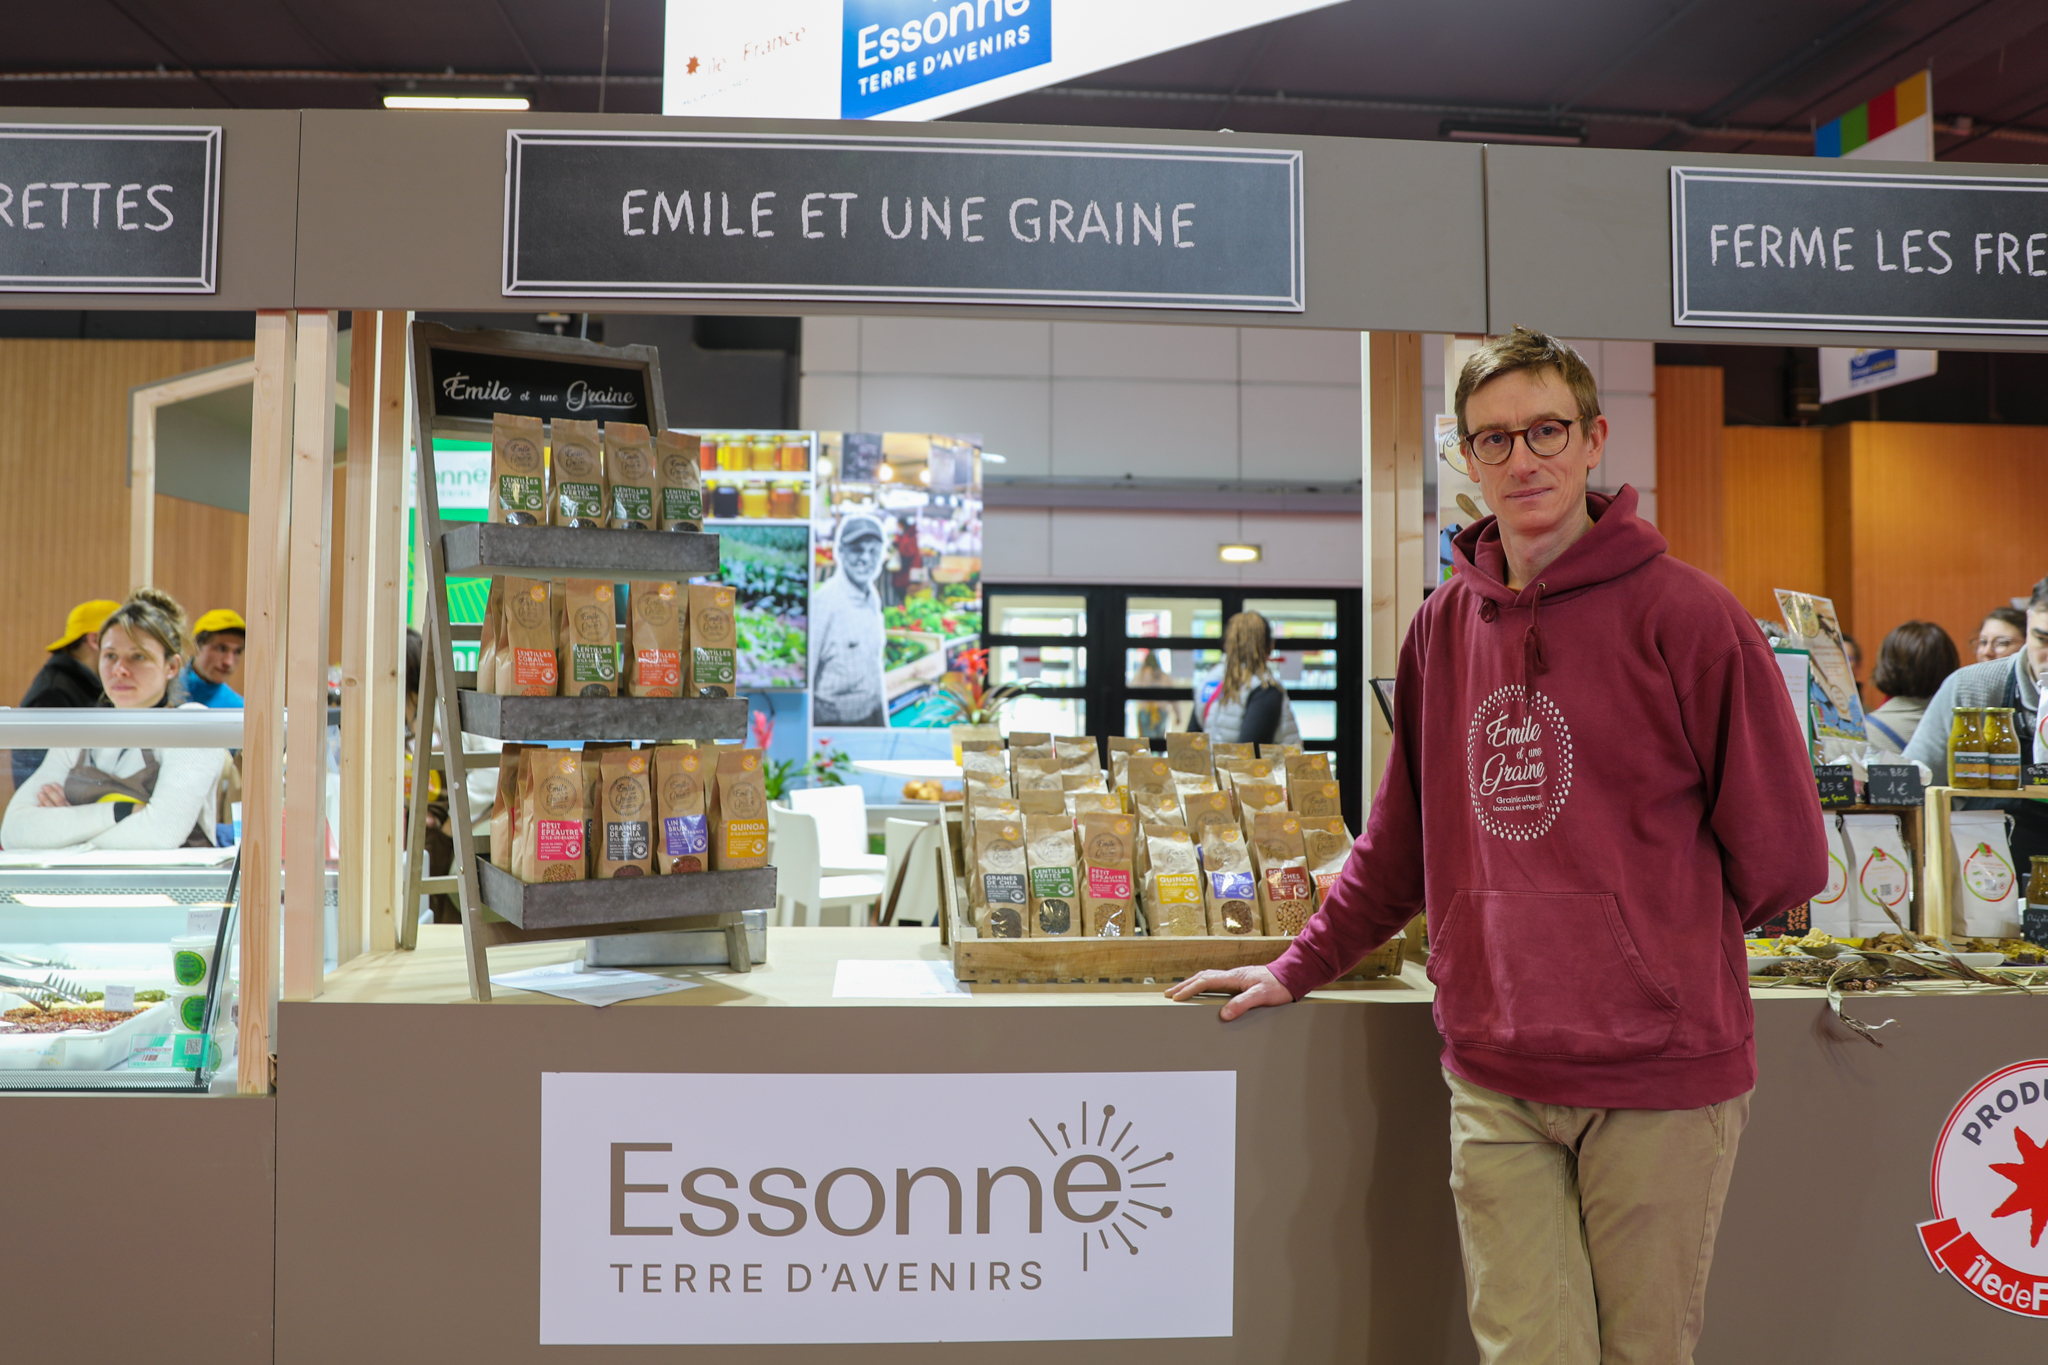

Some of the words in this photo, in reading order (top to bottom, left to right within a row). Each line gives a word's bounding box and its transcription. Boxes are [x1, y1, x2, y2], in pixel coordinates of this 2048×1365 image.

[857, 0, 1031, 69] Essonne
[858, 60, 917, 96] TERRE
[922, 24, 1031, 76] D'AVENIRS
[622, 188, 777, 239] EMILE
[800, 192, 858, 239] ET
[881, 195, 986, 242] UNE
[1009, 197, 1197, 249] GRAINE
[1710, 223, 1855, 272] FERME
[1876, 229, 1954, 276] LES
[1974, 232, 2048, 278] FRE
[442, 371, 511, 402] Émile
[519, 390, 530, 402] et
[539, 393, 559, 403] une
[565, 380, 637, 412] Graine
[563, 484, 598, 492] LENTILLES
[615, 486, 649, 495] LENTILLES
[665, 489, 699, 497] LENTILLES
[517, 649, 552, 658] LENTILLES
[577, 646, 612, 654] LENTILLES
[1486, 710, 1542, 747] Émile
[1516, 746, 1524, 760] et
[1528, 746, 1542, 758] une
[1479, 753, 1546, 796] Graine
[621, 830, 641, 838] CHIA
[730, 823, 765, 831] QUINOA
[1091, 868, 1110, 876] PETIT
[1961, 1078, 2048, 1146] PROD
[609, 1141, 1122, 1237] Essonne
[610, 1262, 763, 1293] TERRE
[787, 1260, 1043, 1293] D'AVENIRS
